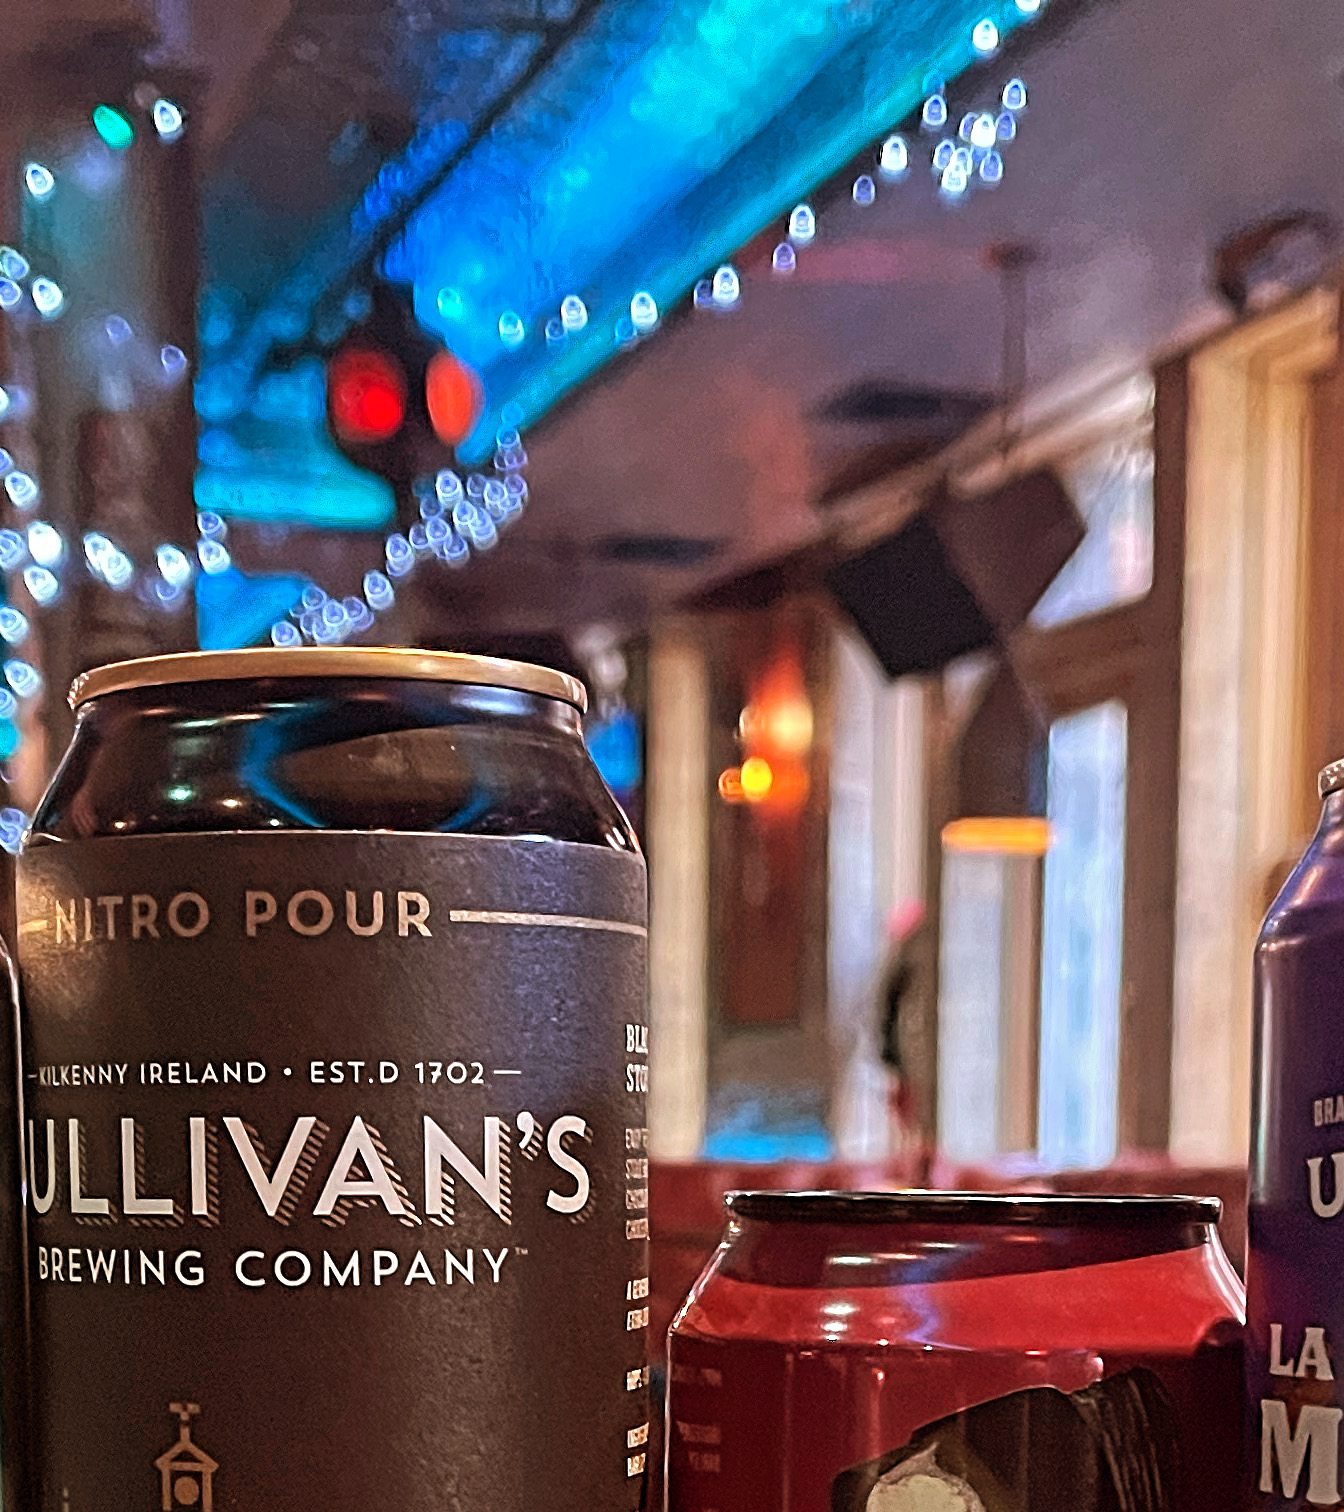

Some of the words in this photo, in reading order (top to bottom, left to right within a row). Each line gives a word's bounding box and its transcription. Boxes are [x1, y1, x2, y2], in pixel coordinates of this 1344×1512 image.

[56, 892, 210, 944] NITRO
[246, 889, 433, 938] POUR
[39, 1063, 127, 1086] KILKENNY
[140, 1061, 266, 1085] IRELAND
[310, 1061, 399, 1085] EST.D
[414, 1061, 485, 1084] 1702
[28, 1111, 593, 1226] ULLIVAN'S
[38, 1248, 204, 1286] BREWING
[1269, 1323, 1334, 1382] LA
